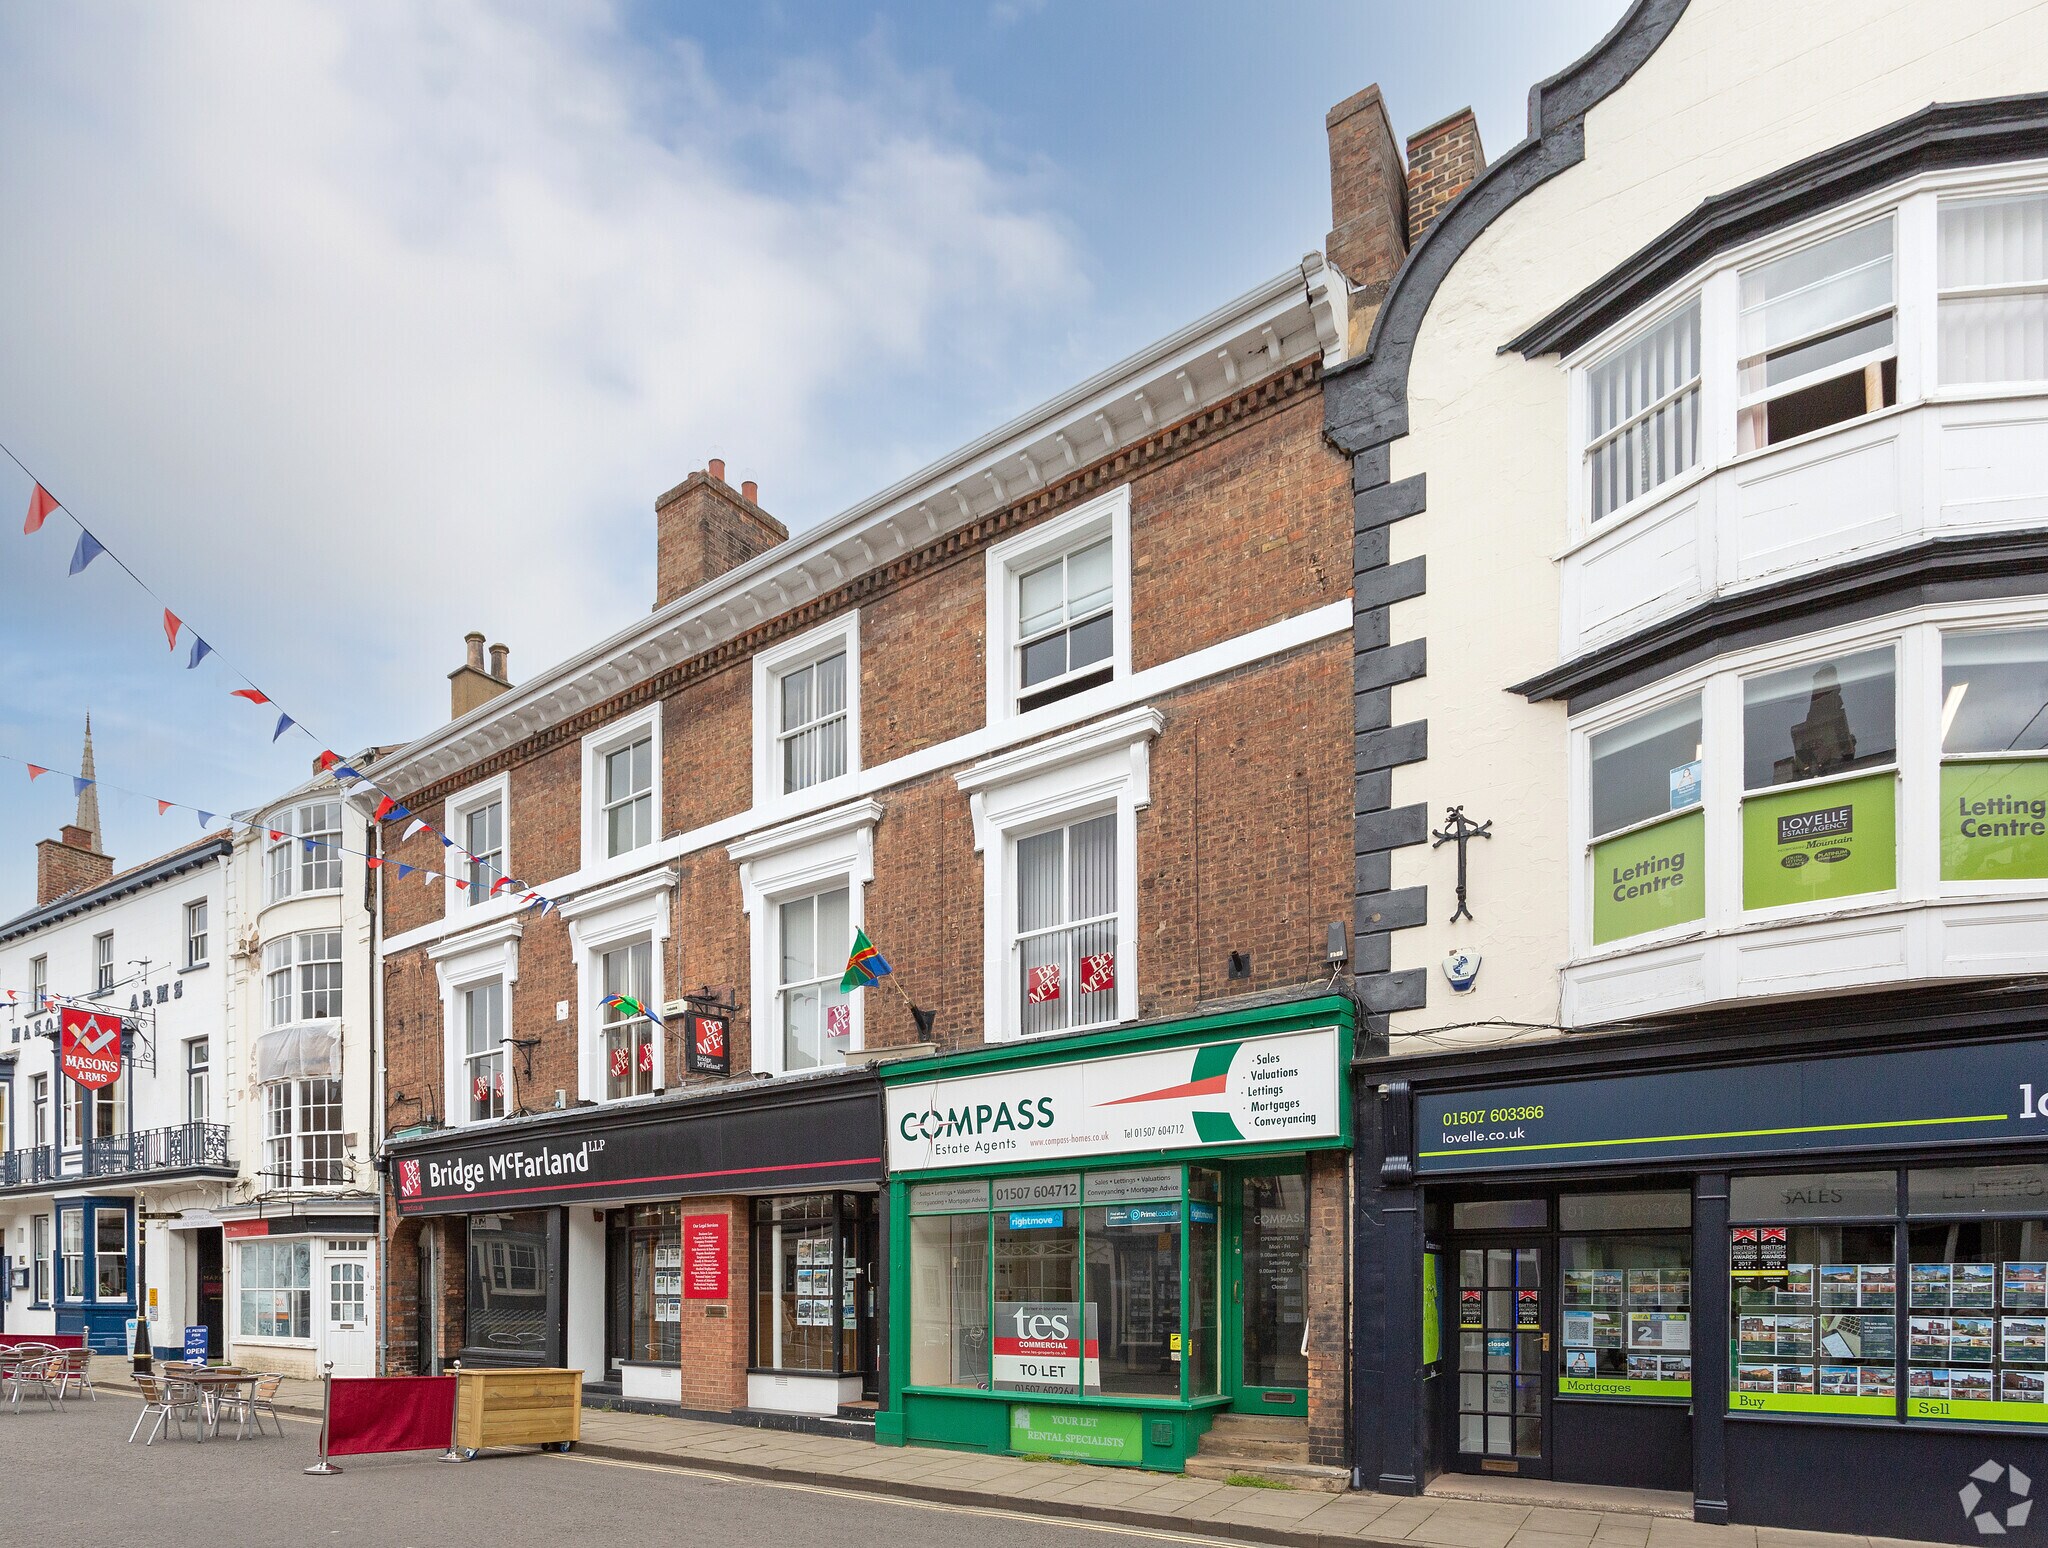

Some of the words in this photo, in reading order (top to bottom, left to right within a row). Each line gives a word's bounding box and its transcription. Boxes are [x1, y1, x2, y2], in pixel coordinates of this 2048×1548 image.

[1960, 794, 2046, 819] Letting
[1782, 809, 1848, 831] LOVELLE
[1782, 828, 1809, 838] ESTATE
[1811, 821, 1848, 833] AGENCY
[1960, 818, 2046, 838] Centre
[1806, 836, 1853, 850] Mountain
[1613, 852, 1685, 885] Letting
[1613, 873, 1684, 902] Centre
[129, 980, 183, 1012] ARMS
[65, 1055, 119, 1073] MASONS
[696, 1055, 712, 1063] Bridge
[1256, 1053, 1280, 1065] Sales
[77, 1072, 108, 1083] ARMS
[1250, 1067, 1299, 1081] Valuations
[1247, 1085, 1284, 1097] Lettings
[1251, 1099, 1300, 1114] Mortgages
[900, 1096, 1055, 1142] COMPASS
[1254, 1112, 1317, 1128] Conveyancing
[1443, 1110, 1486, 1126] 01507
[1490, 1105, 1544, 1122] 603366
[1030, 1131, 1110, 1147] www.compass-homes.co.uk
[1124, 1128, 1133, 1139] Tel
[1134, 1126, 1156, 1138] 01507
[1158, 1124, 1185, 1136] 604712
[1442, 1127, 1525, 1144] lovelle.co.uk
[935, 1143, 970, 1155] Estate
[975, 1138, 1017, 1155] Agents
[429, 1157, 484, 1192] Bridge
[489, 1142, 589, 1181] McFarland
[588, 1140, 605, 1152] LLP
[1113, 1177, 1136, 1185] Lettings
[996, 1187, 1030, 1201] 01507
[1033, 1183, 1077, 1198] 604712
[1087, 1188, 1125, 1196] Conveyancing
[1130, 1186, 1158, 1194] Mortgage
[1781, 1188, 1843, 1205] SALES
[1011, 1215, 1053, 1228] rightmove
[1140, 1210, 1178, 1218] PrimeLocation
[1191, 1209, 1213, 1219] rightmove
[1253, 1213, 1305, 1225] COMPASS
[1233, 1236, 1239, 1245] 7
[1013, 1306, 1069, 1341] tes
[1637, 1326, 1653, 1341] 2
[1018, 1341, 1068, 1349] COMMERCIAL
[1020, 1364, 1037, 1376] TO
[1041, 1365, 1066, 1377] LET
[1567, 1380, 1631, 1394] Mortgages
[1739, 1395, 1765, 1409] Buy
[1918, 1402, 1950, 1415] Sell
[1052, 1415, 1078, 1426] YOUR
[1080, 1418, 1098, 1427] LET
[1028, 1431, 1064, 1443] RENTAL
[1065, 1434, 1124, 1447] SPECIALISTS
